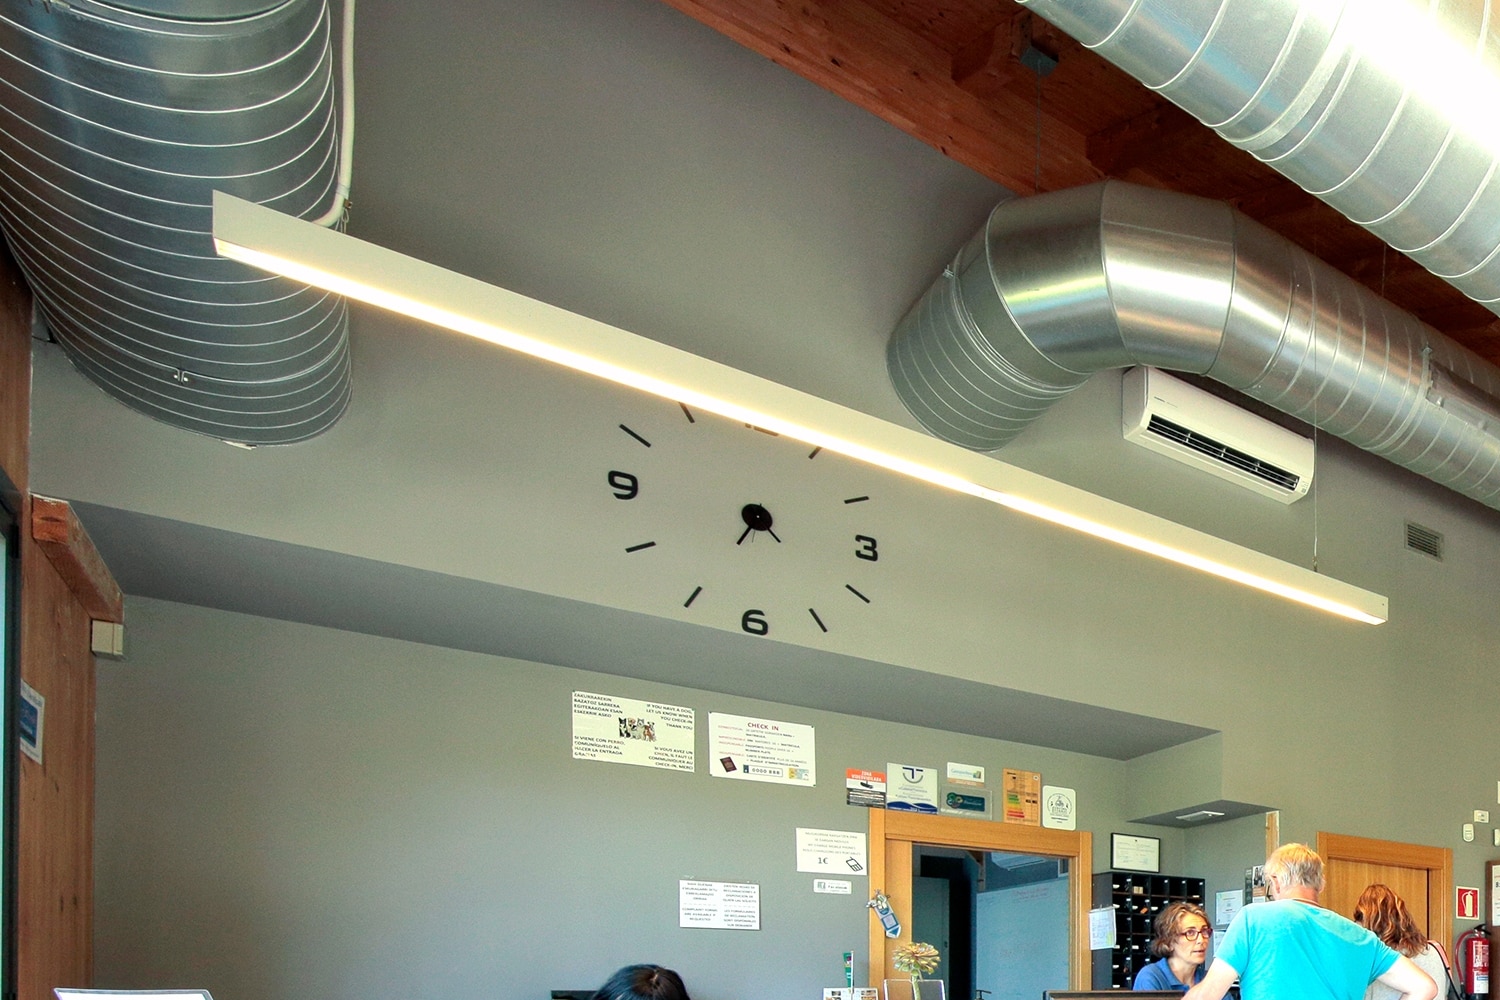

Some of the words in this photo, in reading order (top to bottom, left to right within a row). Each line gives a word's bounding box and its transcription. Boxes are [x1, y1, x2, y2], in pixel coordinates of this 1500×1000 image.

[607, 470, 639, 500] 9
[854, 534, 879, 562] 3
[741, 609, 769, 636] 6
[747, 722, 769, 730] CHECK
